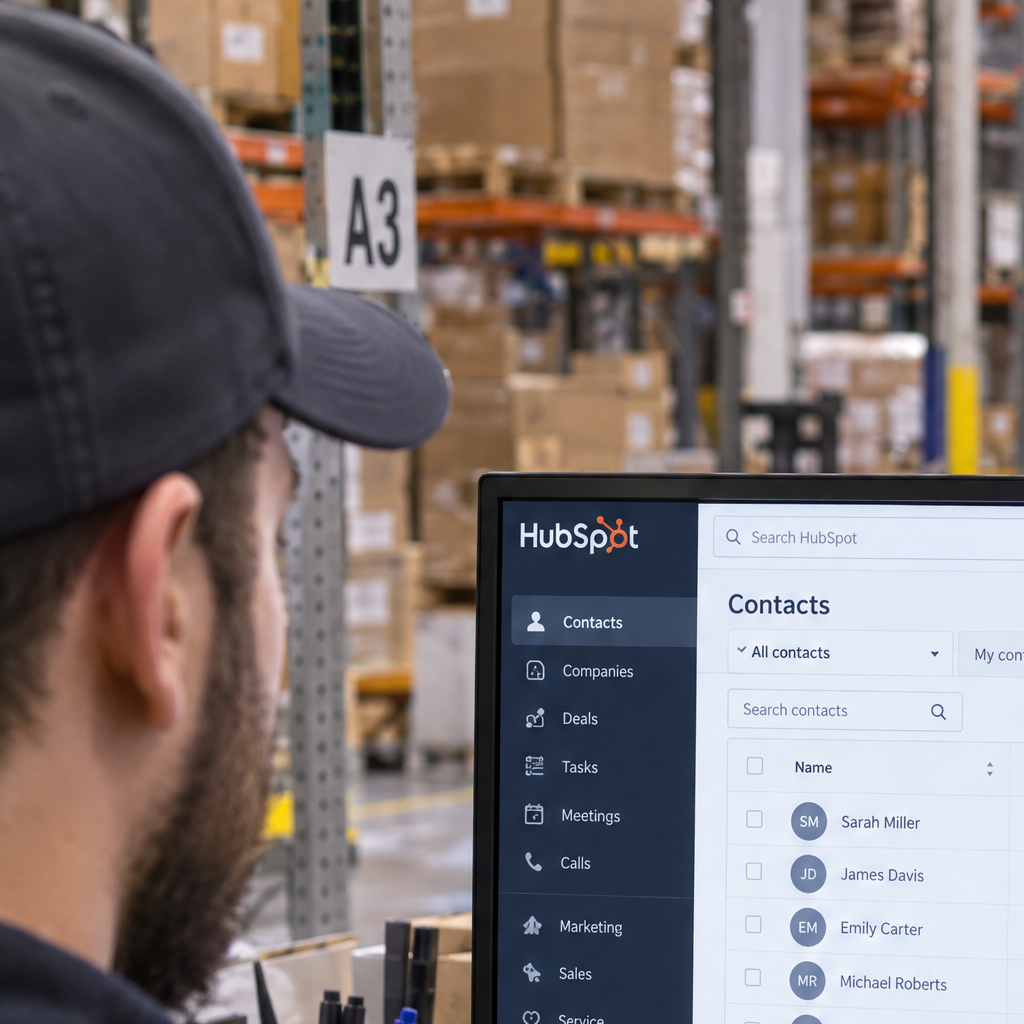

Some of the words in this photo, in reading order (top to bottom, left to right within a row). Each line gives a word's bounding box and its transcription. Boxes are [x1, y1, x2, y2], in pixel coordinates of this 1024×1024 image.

[345, 176, 401, 267] A3
[519, 515, 640, 554] HubSpot
[751, 530, 796, 543] Search
[800, 530, 858, 547] HubSpot
[728, 593, 831, 614] Contacts
[563, 615, 623, 629] Contacts
[751, 644, 769, 658] All
[772, 646, 831, 659] contacts
[974, 647, 995, 664] My
[562, 663, 634, 680] Companies
[743, 702, 788, 716] Search
[791, 704, 848, 716] contacts
[562, 711, 599, 725] Deals
[561, 759, 599, 773] Tasks
[795, 760, 833, 773] Name
[561, 808, 621, 825] Meetings
[799, 815, 819, 827] SM
[841, 815, 880, 828] Sarah
[884, 815, 921, 829] Miller
[560, 856, 591, 869] Calls
[800, 867, 817, 879] JD
[840, 867, 885, 881] James
[888, 868, 925, 882] Davis
[559, 919, 623, 937] Marketing
[798, 920, 818, 933] EM
[840, 920, 878, 937] Emily
[880, 921, 924, 935] Carter
[559, 966, 593, 980] Sales
[797, 974, 818, 986] MR
[840, 974, 891, 989] Michael
[895, 976, 948, 991] Roberts
